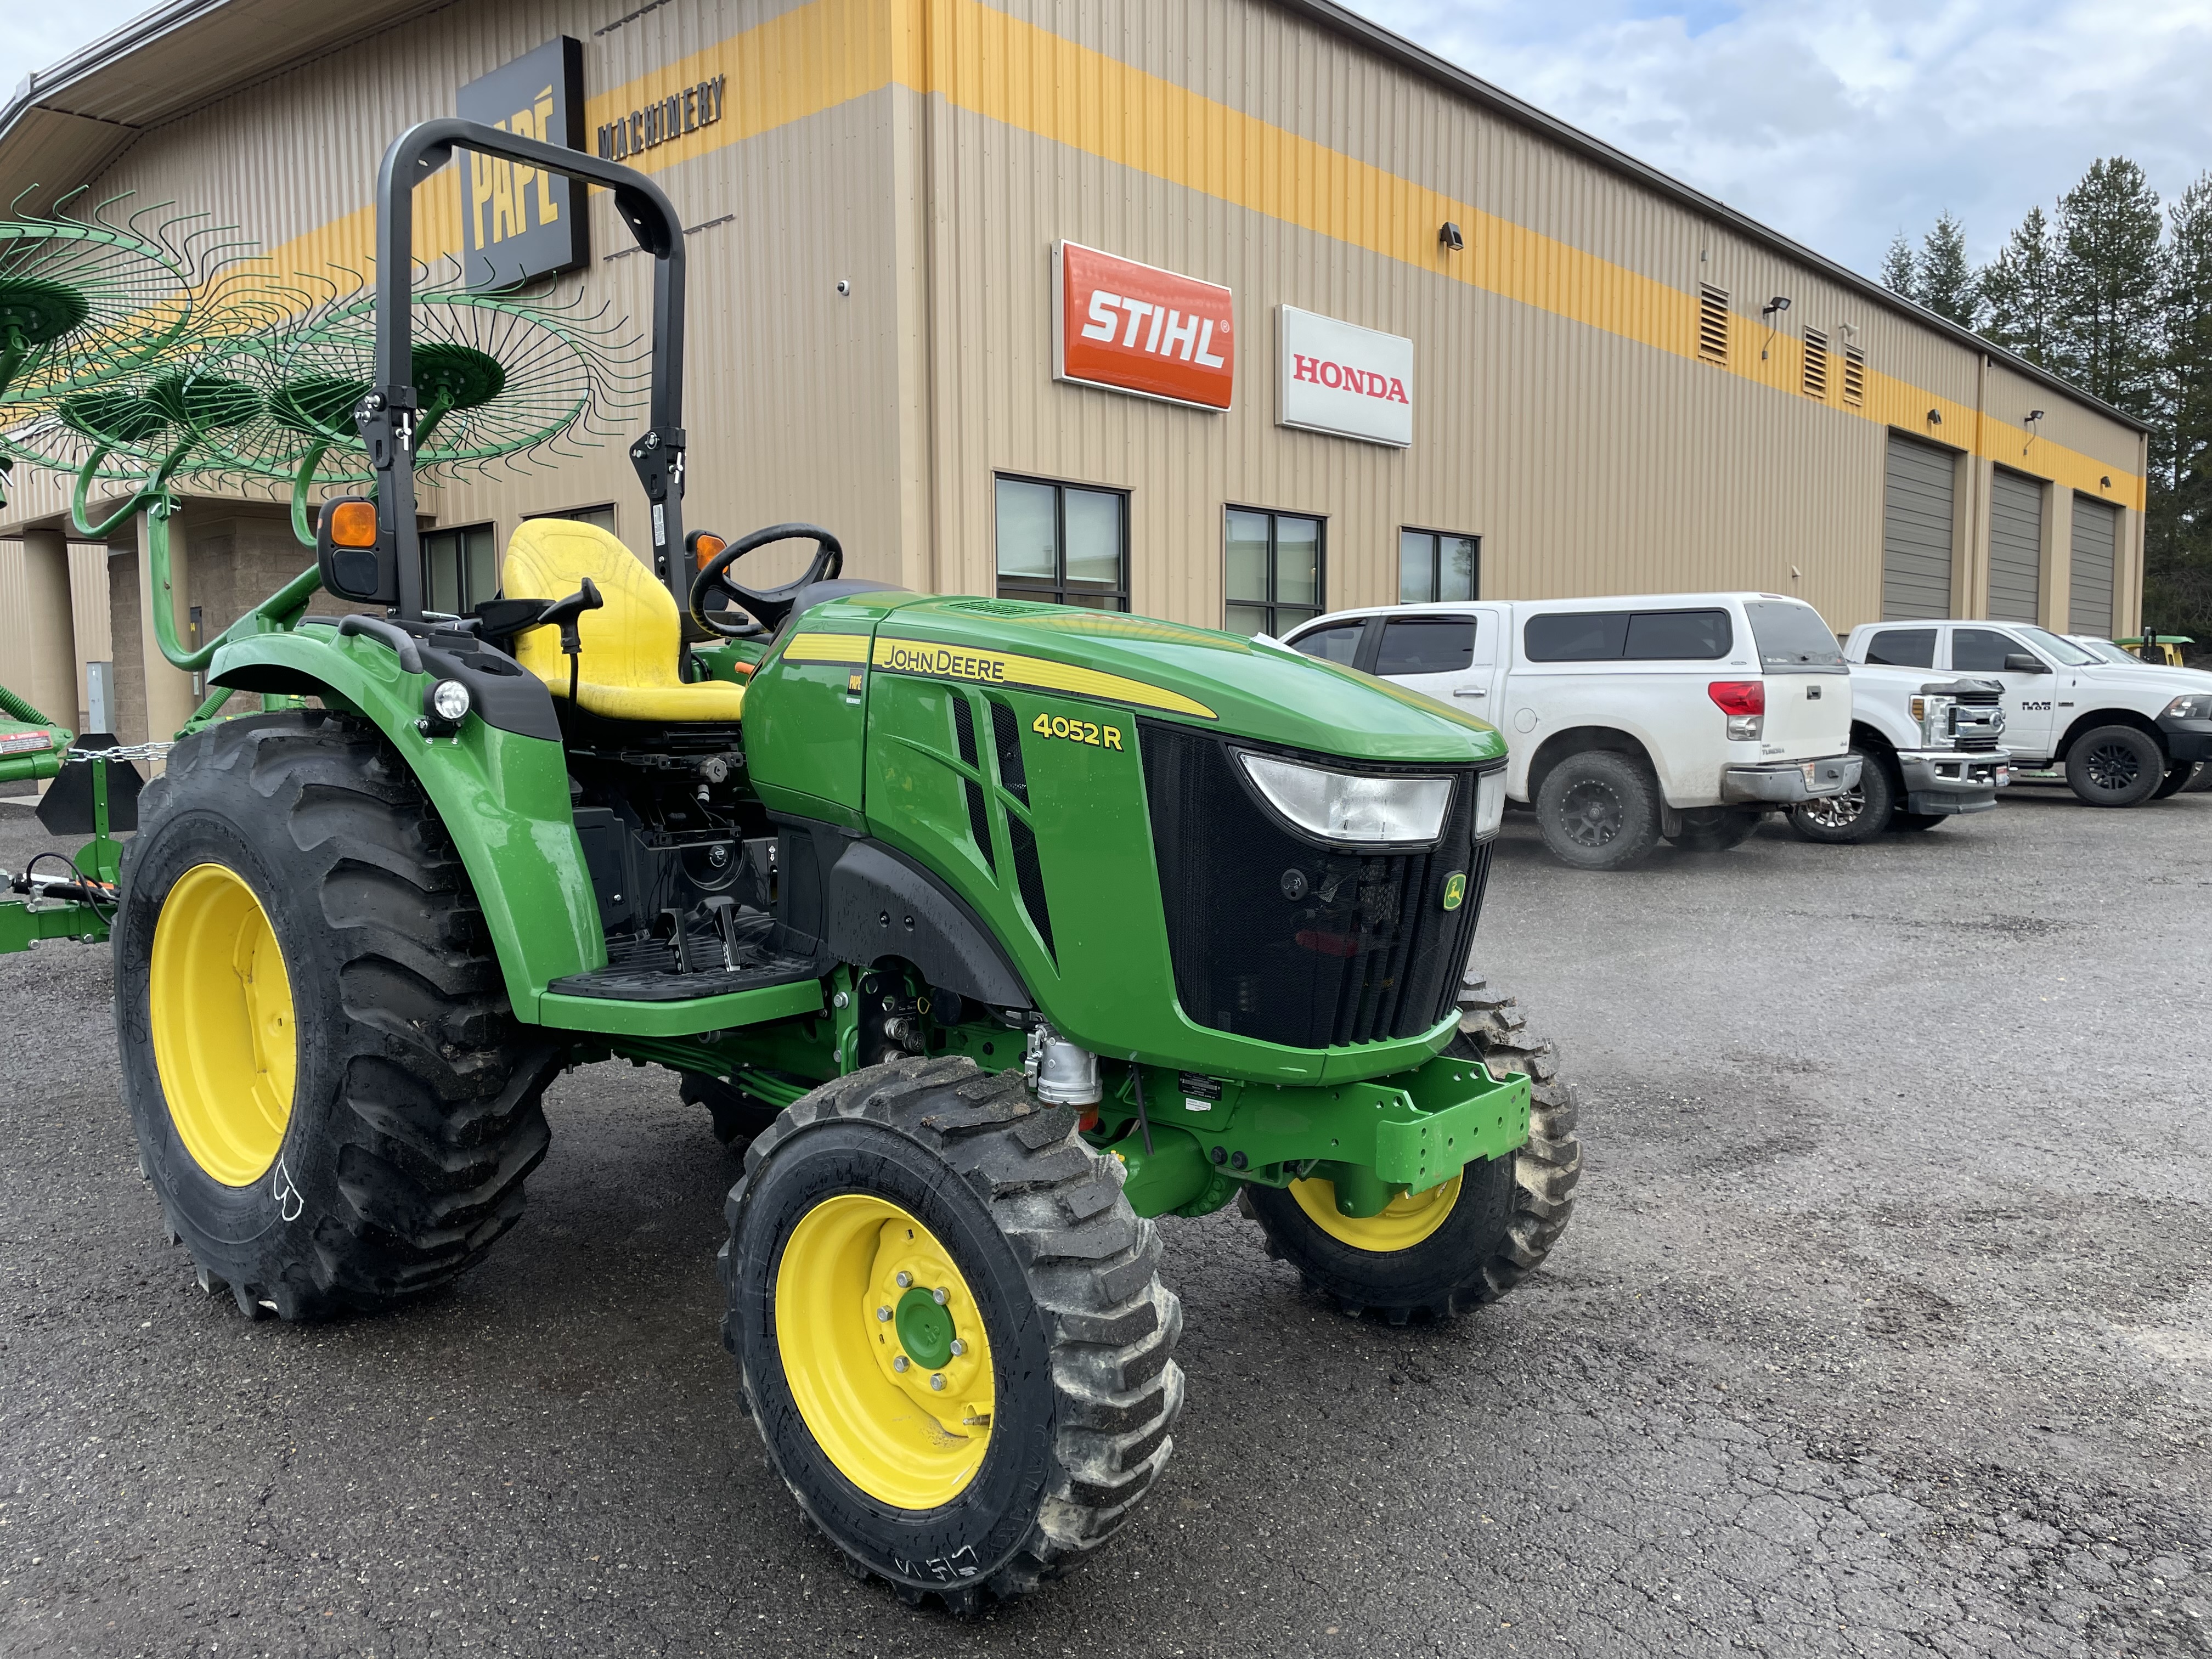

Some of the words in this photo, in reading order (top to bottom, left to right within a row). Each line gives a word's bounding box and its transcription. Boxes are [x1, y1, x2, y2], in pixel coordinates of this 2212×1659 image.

[598, 73, 724, 161] MACHINERY
[470, 84, 559, 251] PAPÉ
[1081, 289, 1225, 369] STIHL
[1293, 353, 1410, 404] HONDA
[884, 645, 933, 670] JOHN
[936, 650, 1005, 680] DEERE
